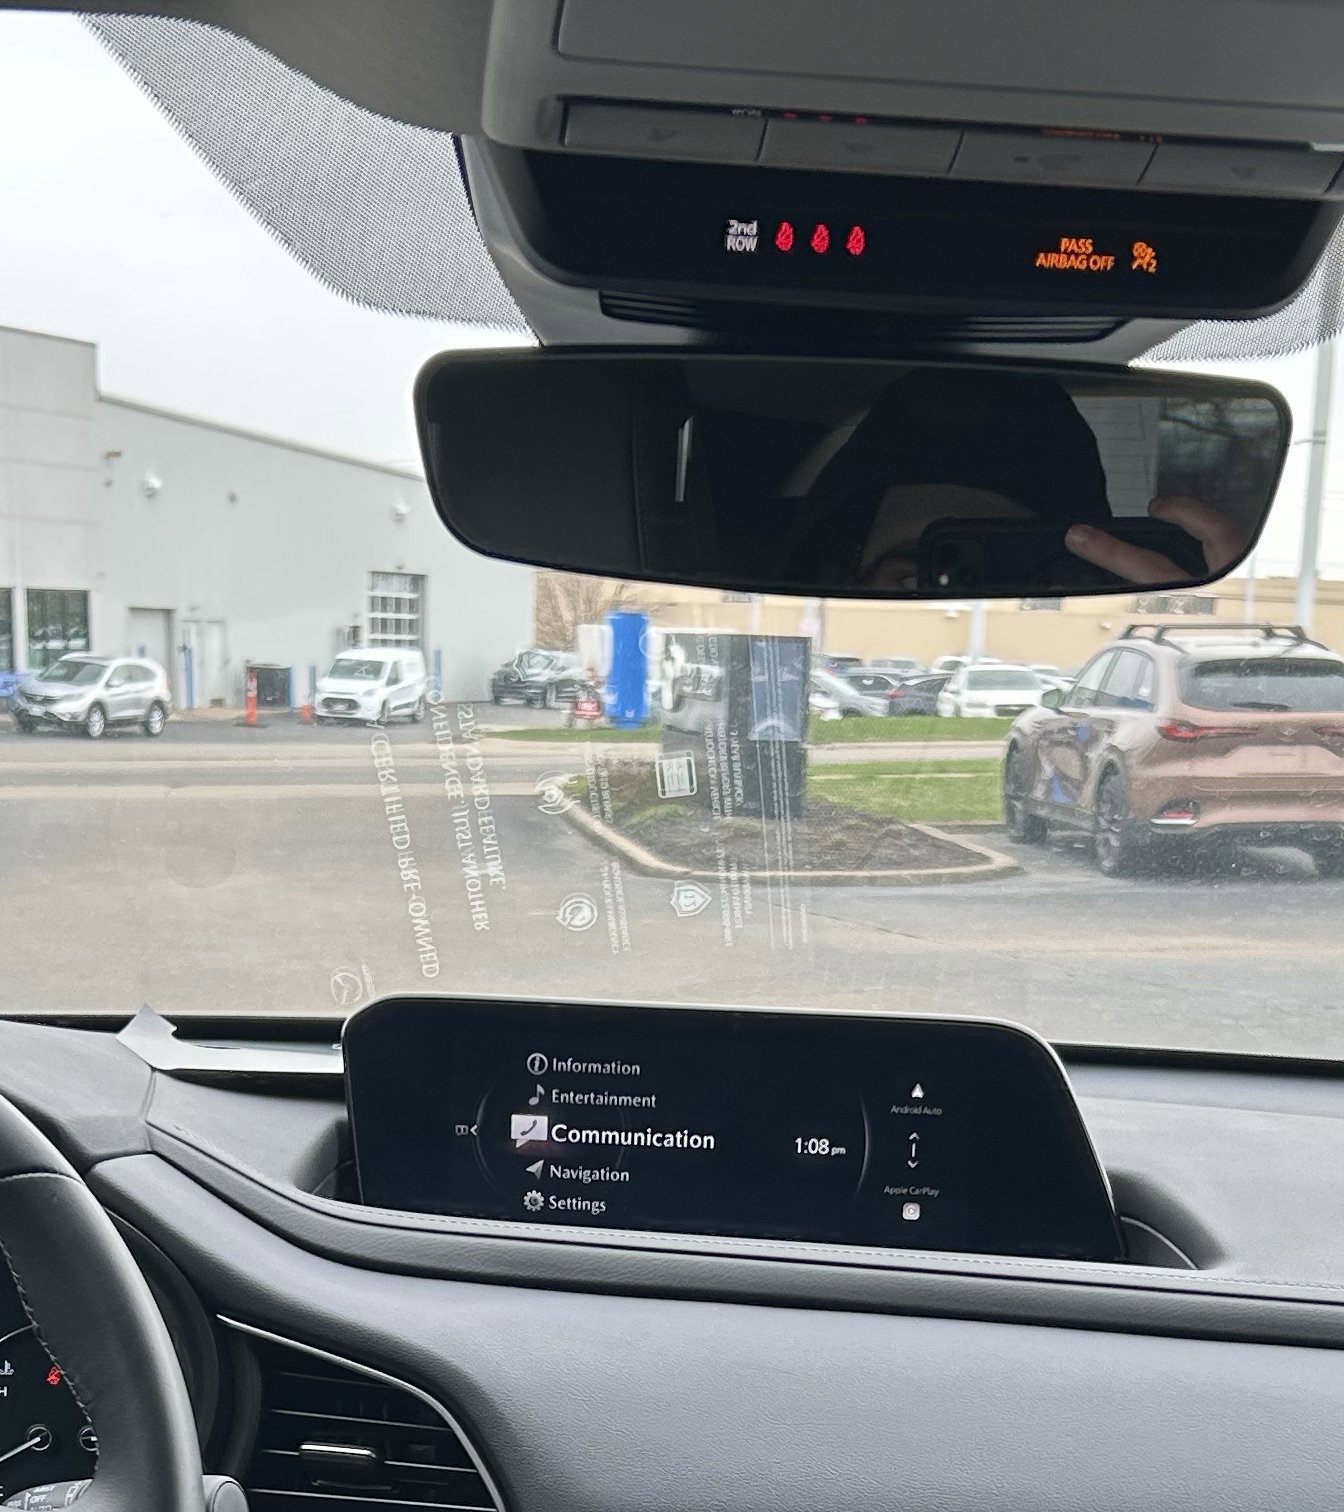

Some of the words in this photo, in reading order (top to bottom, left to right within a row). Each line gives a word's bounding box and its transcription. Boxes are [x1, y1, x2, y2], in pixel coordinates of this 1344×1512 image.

[727, 220, 758, 236] 2nd
[725, 236, 758, 252] ROW
[1060, 238, 1093, 254] PASS
[1035, 253, 1087, 270] AIRBAG
[1089, 255, 1116, 271] OFF
[552, 1057, 641, 1076] Information
[552, 1088, 656, 1108] Entertainment
[890, 1104, 922, 1115] Android
[923, 1106, 943, 1116] Auto
[551, 1124, 715, 1150] Communication
[795, 1136, 830, 1155] 1:08
[831, 1146, 846, 1156] pm
[549, 1164, 630, 1184] Navigation
[883, 1185, 908, 1196] Apple
[909, 1186, 940, 1198] CarPlay
[549, 1195, 606, 1216] Settings
[30, 1494, 48, 1503] OFF
